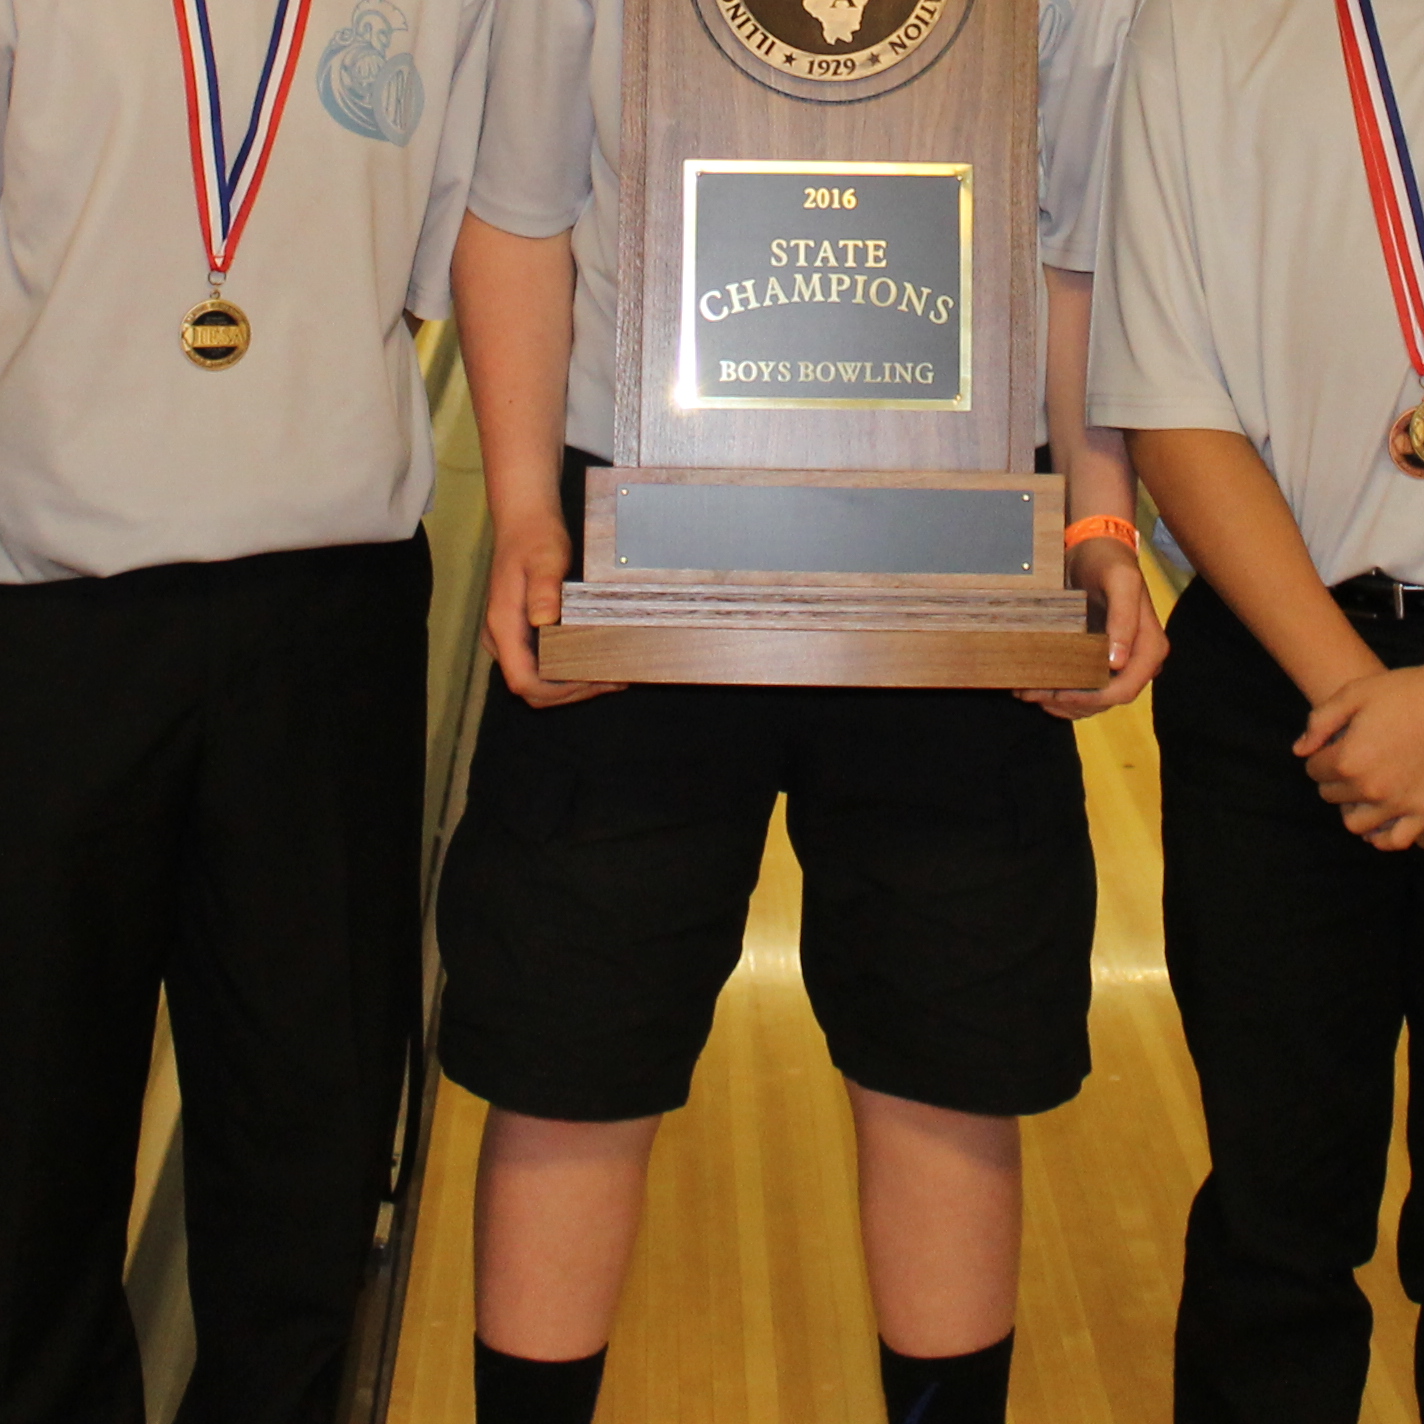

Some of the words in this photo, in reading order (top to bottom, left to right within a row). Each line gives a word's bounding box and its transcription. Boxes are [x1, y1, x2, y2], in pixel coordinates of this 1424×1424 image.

[806, 58, 857, 77] 1929
[803, 187, 858, 210] 2016
[770, 239, 888, 268] STATE
[699, 273, 955, 325] CHAMPIONS
[719, 360, 791, 383] BOYS
[798, 360, 935, 385] BOWLING
